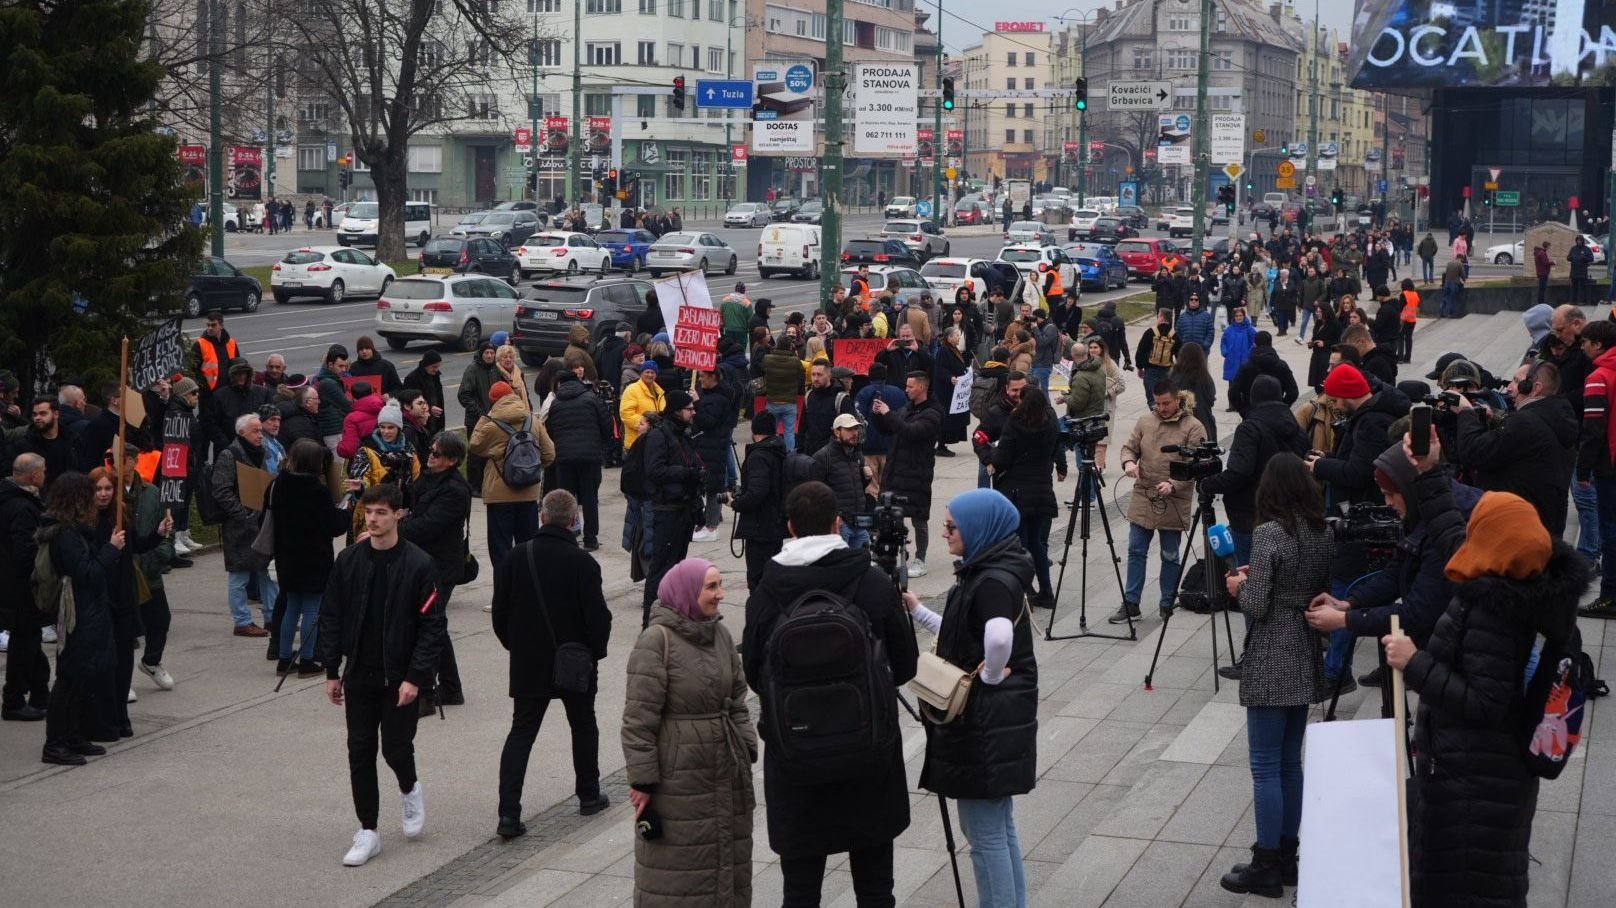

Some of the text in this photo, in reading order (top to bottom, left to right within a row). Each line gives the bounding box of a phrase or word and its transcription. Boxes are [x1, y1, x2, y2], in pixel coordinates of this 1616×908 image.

[994, 21, 1046, 32] ERONET
[862, 68, 911, 77] PRODAJA
[862, 80, 910, 88] STANOVA
[1111, 85, 1151, 94] Kovačići
[721, 88, 744, 99] Tuzla
[1111, 97, 1153, 105] Grbavica
[868, 104, 892, 112] 3.300
[865, 131, 906, 139] 062 711 111
[784, 157, 817, 168] PROSTOR
[227, 147, 236, 197] CASINO
[164, 412, 190, 438] ZLOČIN
[166, 447, 180, 469] BEZ
[160, 479, 184, 502] KAZNE
